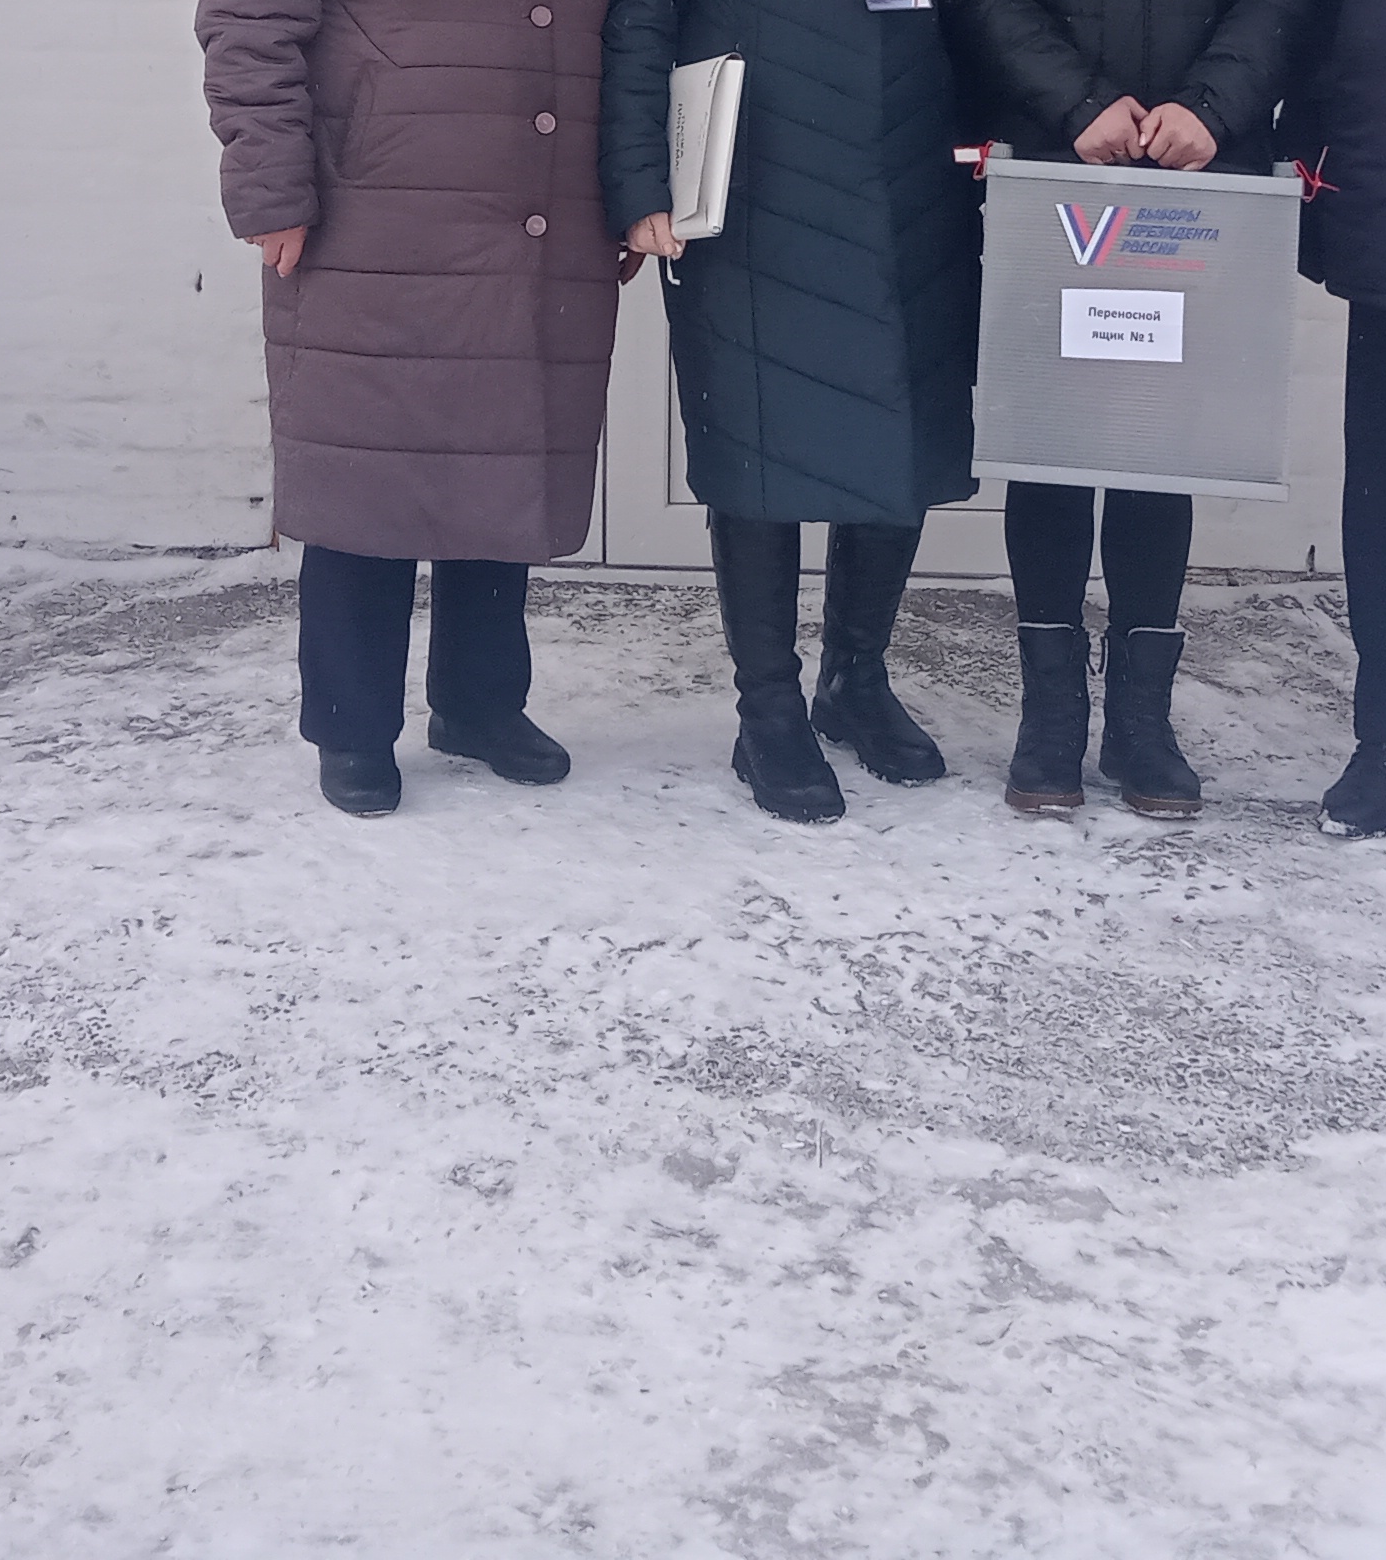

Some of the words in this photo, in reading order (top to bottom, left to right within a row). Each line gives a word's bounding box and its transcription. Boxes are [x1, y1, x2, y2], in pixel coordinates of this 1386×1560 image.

[1088, 306, 1161, 321] Переносной
[1091, 330, 1124, 342] ящик
[1129, 331, 1145, 342] №
[1148, 332, 1155, 343] 1
